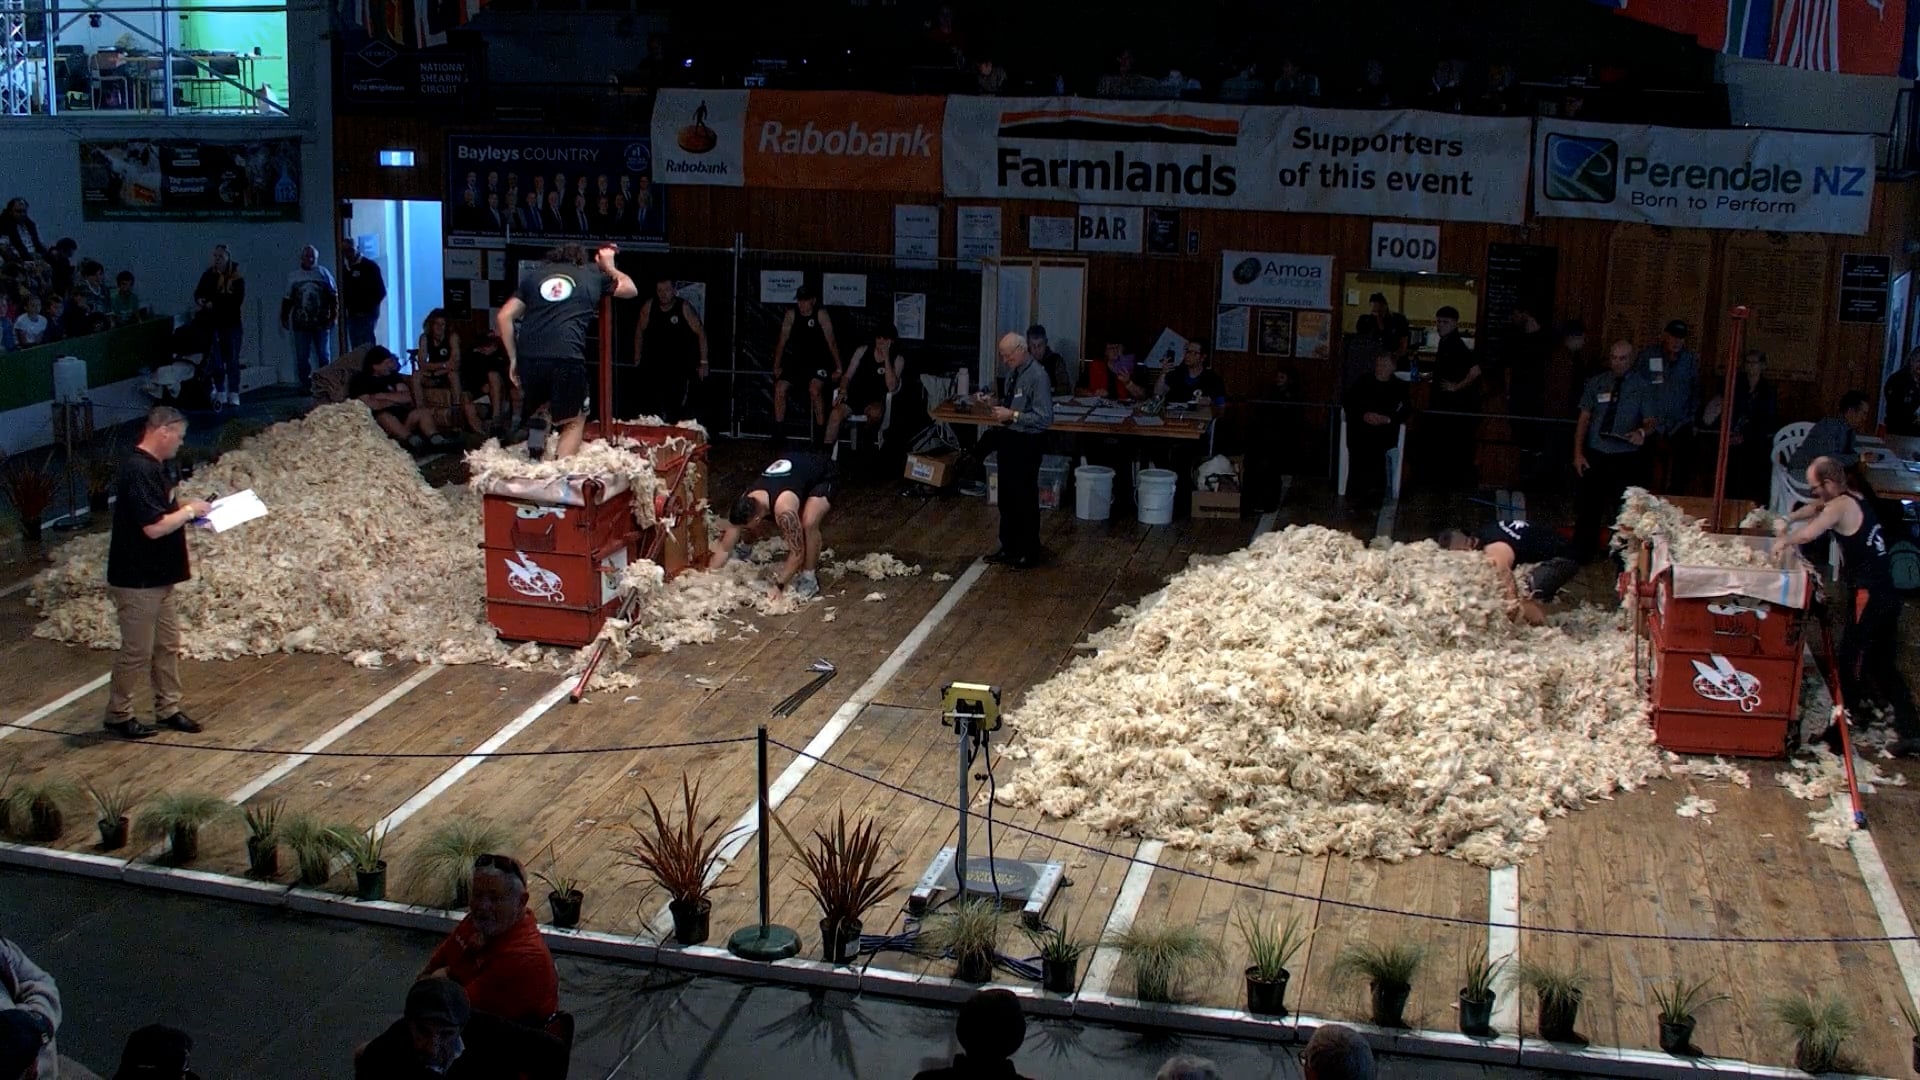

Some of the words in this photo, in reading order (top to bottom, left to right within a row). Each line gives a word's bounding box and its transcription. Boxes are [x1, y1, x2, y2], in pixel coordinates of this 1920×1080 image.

[420, 84, 457, 94] CIRCUIT
[758, 120, 933, 158] Rabobank
[1292, 126, 1463, 158] Supporters
[457, 144, 519, 162] Bayleys
[523, 147, 600, 161] COUNTRY
[666, 159, 728, 176] Rabobank
[998, 148, 1236, 196] Farmlands
[1624, 156, 1804, 194] Perendale
[1813, 167, 1865, 196] NZ
[1279, 163, 1310, 189] of
[1319, 165, 1376, 190] this
[1387, 172, 1473, 196] event
[1631, 193, 1677, 209] Born
[1688, 197, 1709, 210] to
[1716, 197, 1797, 215] Perform
[1080, 216, 1128, 240] BAR
[1377, 238, 1437, 261] FOOD
[1264, 260, 1322, 279] Amoa
